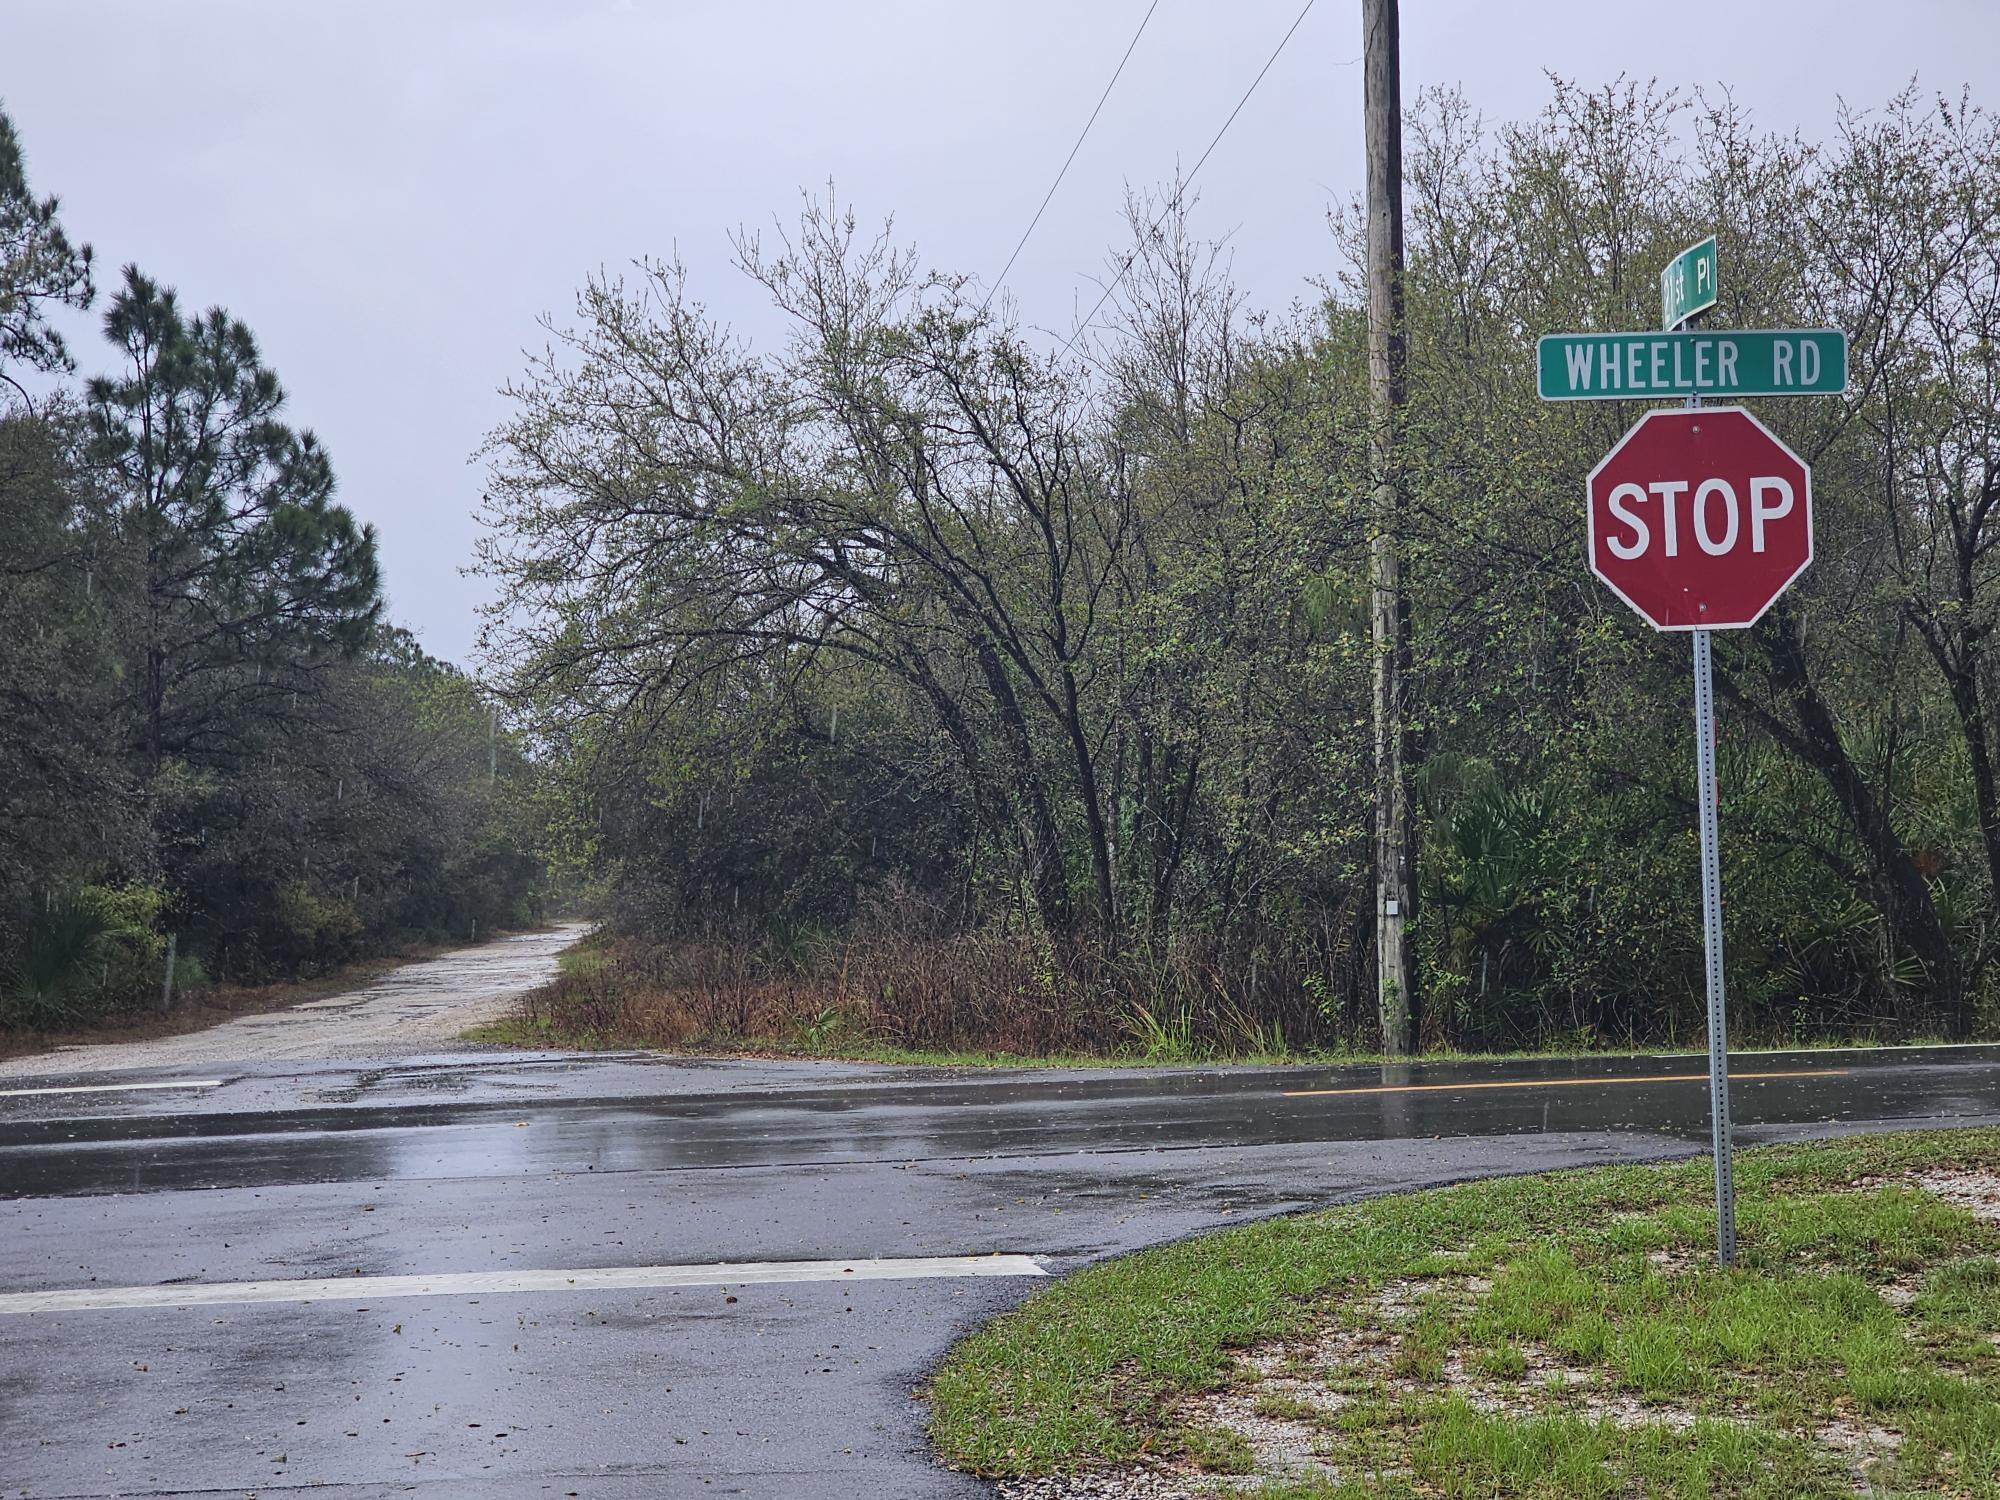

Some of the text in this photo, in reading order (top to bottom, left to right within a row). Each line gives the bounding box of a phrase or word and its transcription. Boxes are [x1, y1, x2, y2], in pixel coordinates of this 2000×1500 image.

[1697, 255, 1711, 295] Pl
[1564, 340, 1821, 390] WHEELER RD
[1606, 476, 1794, 560] STOP
